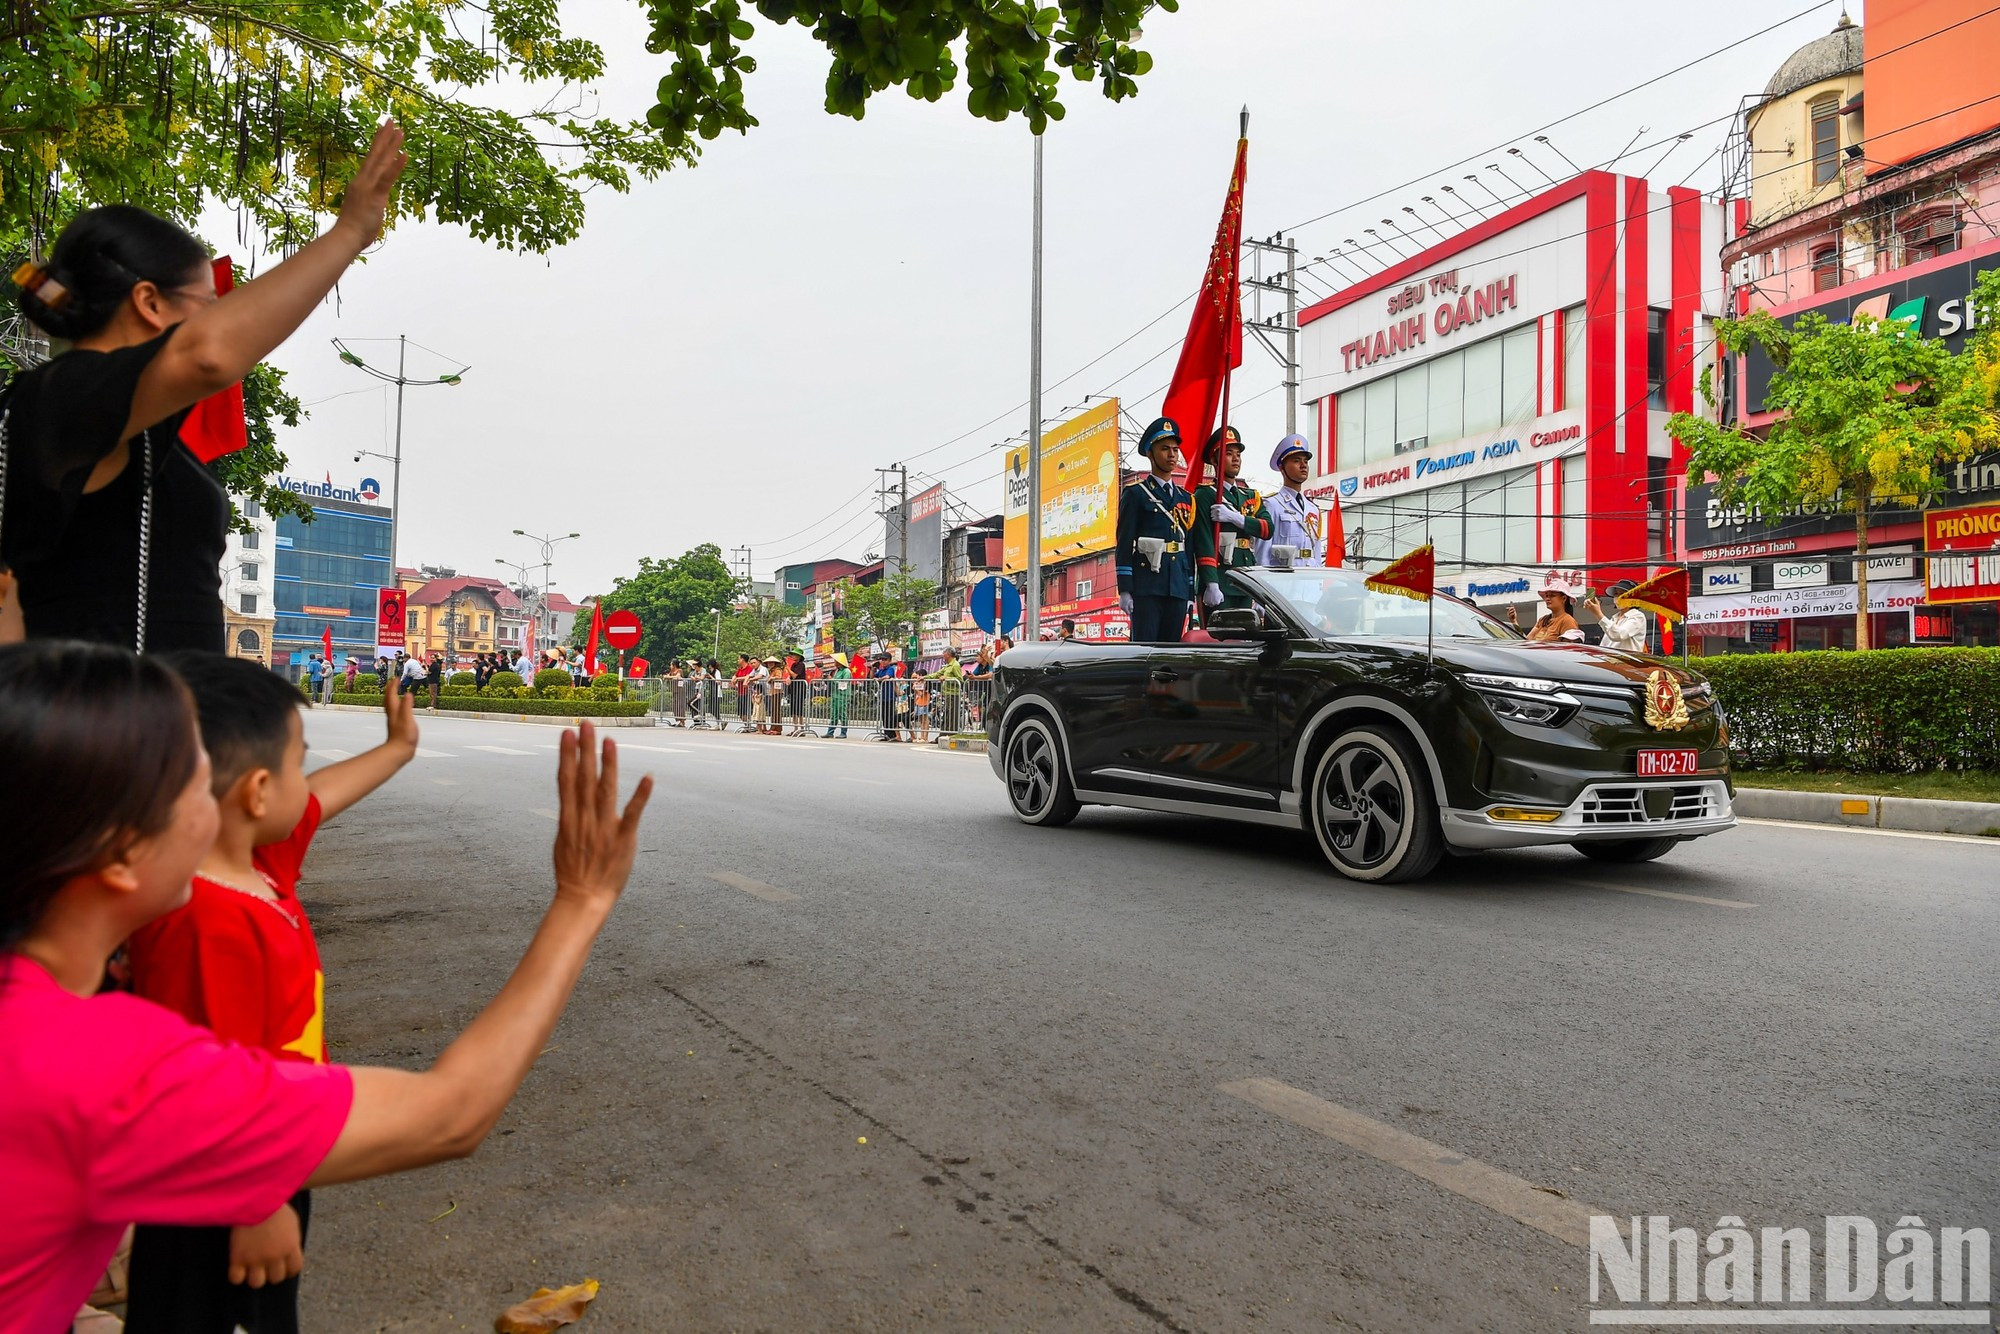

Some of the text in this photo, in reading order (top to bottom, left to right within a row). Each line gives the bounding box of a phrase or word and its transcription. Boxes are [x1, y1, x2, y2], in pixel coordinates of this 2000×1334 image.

[1387, 269, 1458, 315] SIÊU THỊ
[1340, 274, 1517, 372] THANH OÁNH
[1530, 424, 1581, 448] Canon
[1482, 438, 1521, 461] AQUA
[1427, 450, 1475, 475] DAIKIN
[277, 475, 360, 503] VietinBank
[1008, 475, 1029, 495] Doppe
[1363, 466, 1410, 490] HITACHI
[1936, 513, 2000, 539] PHÒNG
[1702, 549, 1717, 560] 898
[1768, 540, 1796, 553] Thanh
[1867, 555, 1906, 569] UAWEI
[1929, 544, 1975, 589] ĐỒNG
[1468, 578, 1531, 597] Panasonic
[1709, 573, 1740, 586] DELL
[1721, 609, 1747, 619] 2.99
[1748, 606, 1779, 618] Triệu
[1792, 602, 1810, 614] Đổi
[1813, 604, 1835, 613] máy
[1838, 602, 1853, 611] 2G
[1887, 596, 1926, 608] 300K
[1750, 593, 1782, 604] Redmi
[1785, 592, 1800, 602] A3
[1639, 752, 1696, 773] TM-02-70
